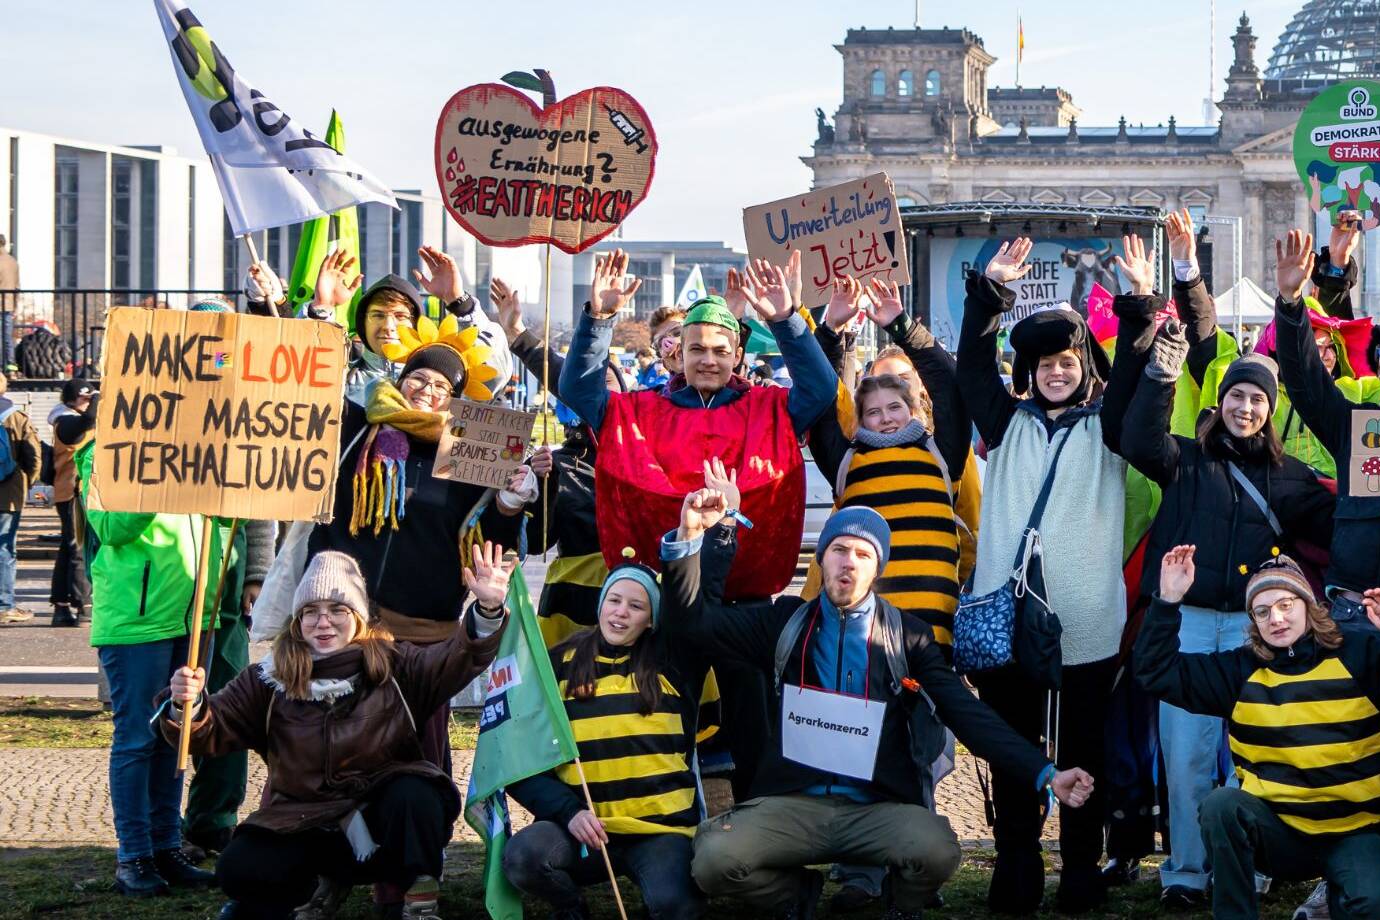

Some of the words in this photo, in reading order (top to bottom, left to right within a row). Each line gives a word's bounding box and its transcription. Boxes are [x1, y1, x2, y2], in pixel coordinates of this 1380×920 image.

[1343, 108, 1374, 117] BUND
[458, 117, 601, 152] ausgewogene
[490, 149, 617, 184] Ernährung?
[450, 175, 633, 224] #EATTHERICH
[766, 192, 892, 245] Umverteilung
[810, 230, 899, 287] Jetzt!
[1021, 282, 1059, 300] STATT
[121, 331, 223, 383] MAKE
[241, 341, 334, 388] LOVE
[112, 386, 184, 430] NOT
[202, 397, 340, 441] MASSEN-
[461, 405, 494, 425] BUNTE
[103, 441, 329, 491] TIERHALTUNG
[450, 441, 498, 462] BRAUNES
[788, 711, 869, 737] Agrarkonzern2
